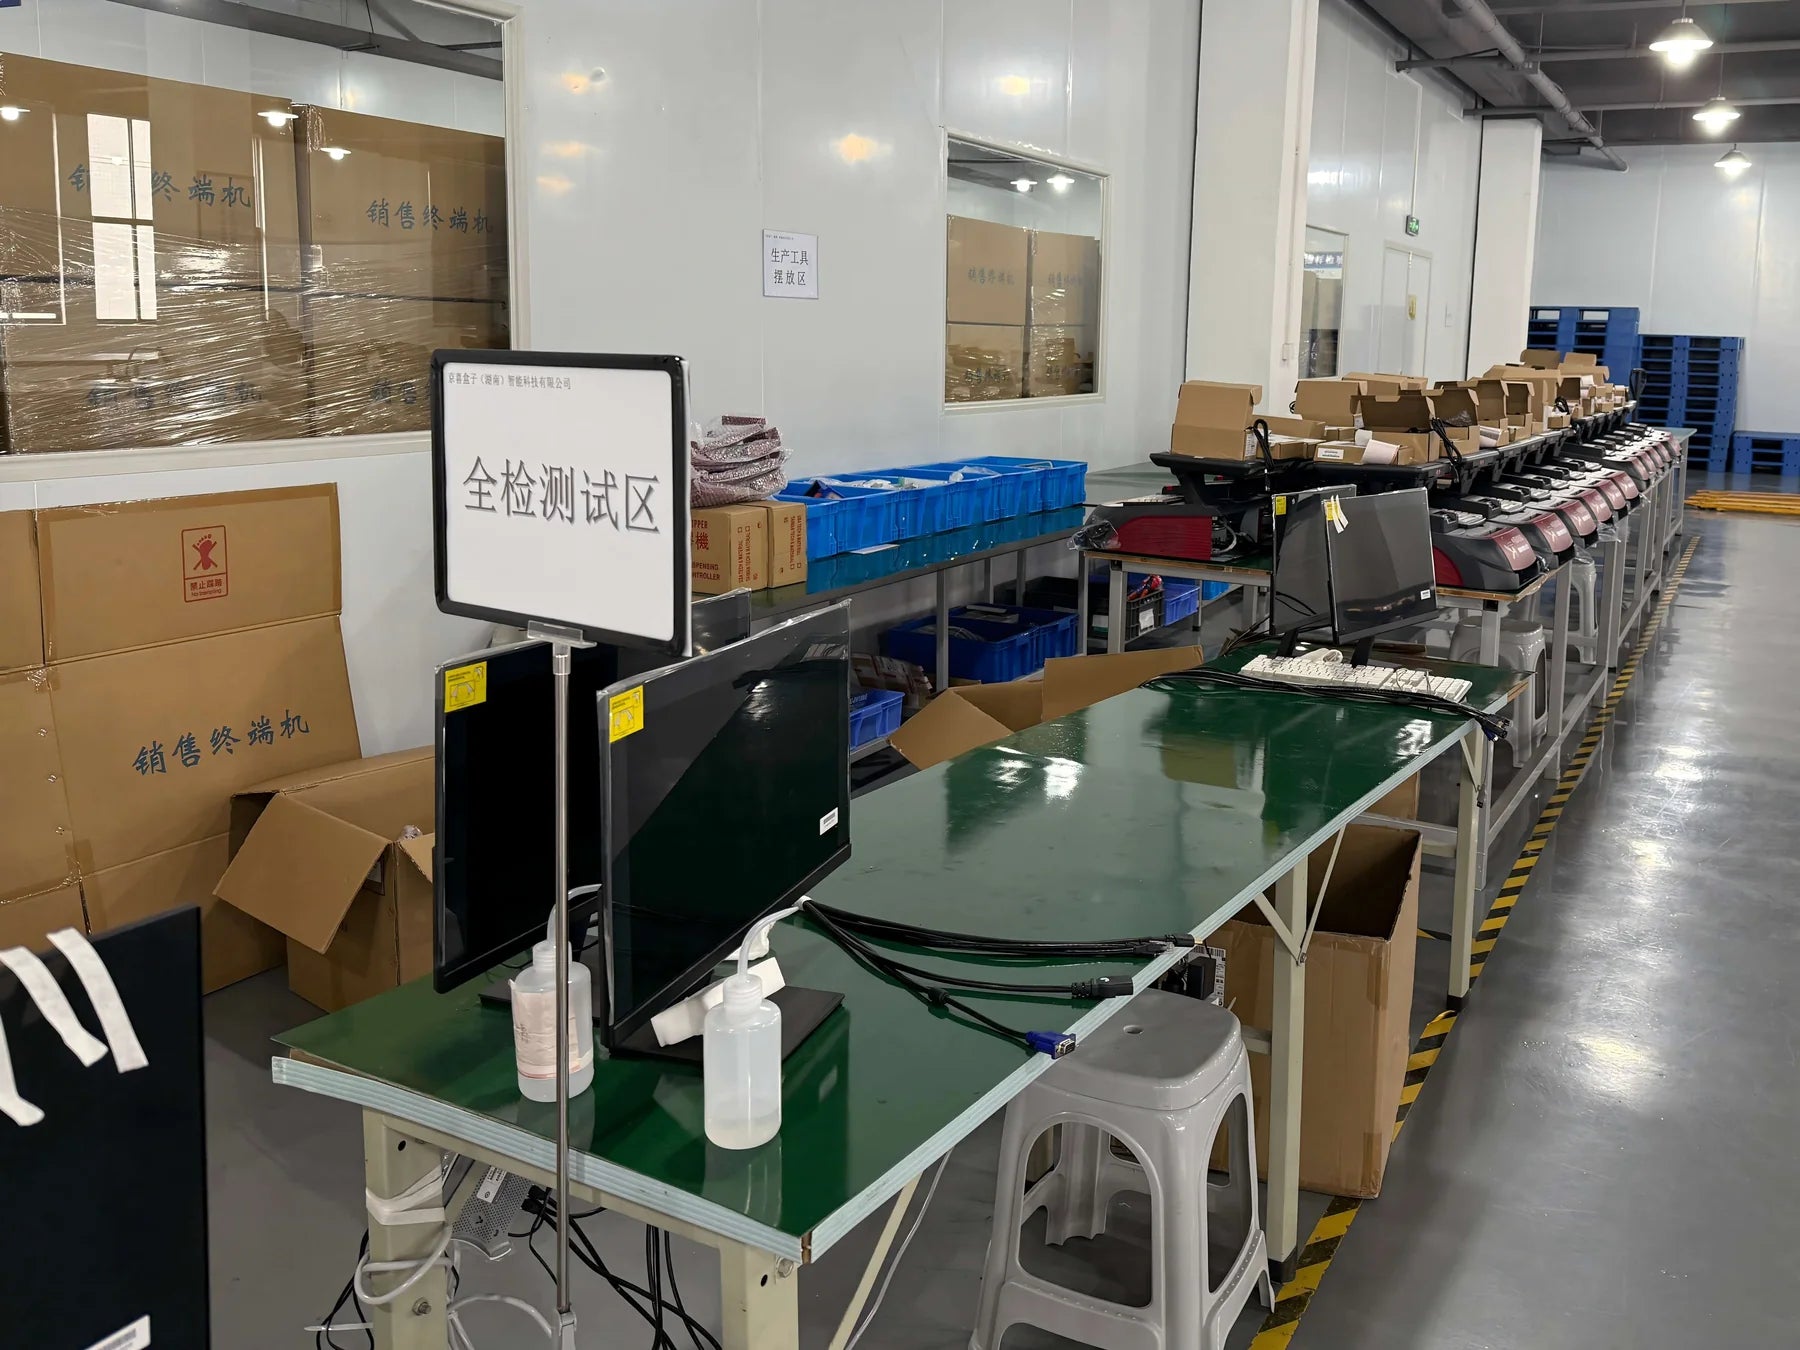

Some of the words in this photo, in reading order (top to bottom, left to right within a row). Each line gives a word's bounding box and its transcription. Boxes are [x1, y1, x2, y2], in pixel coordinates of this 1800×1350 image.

[366, 198, 494, 234] 销售终端机
[771, 247, 809, 265] 生产工具
[774, 269, 806, 286] 摆放区
[463, 455, 660, 534] 全检测试区
[132, 709, 310, 776] 销售终端机
